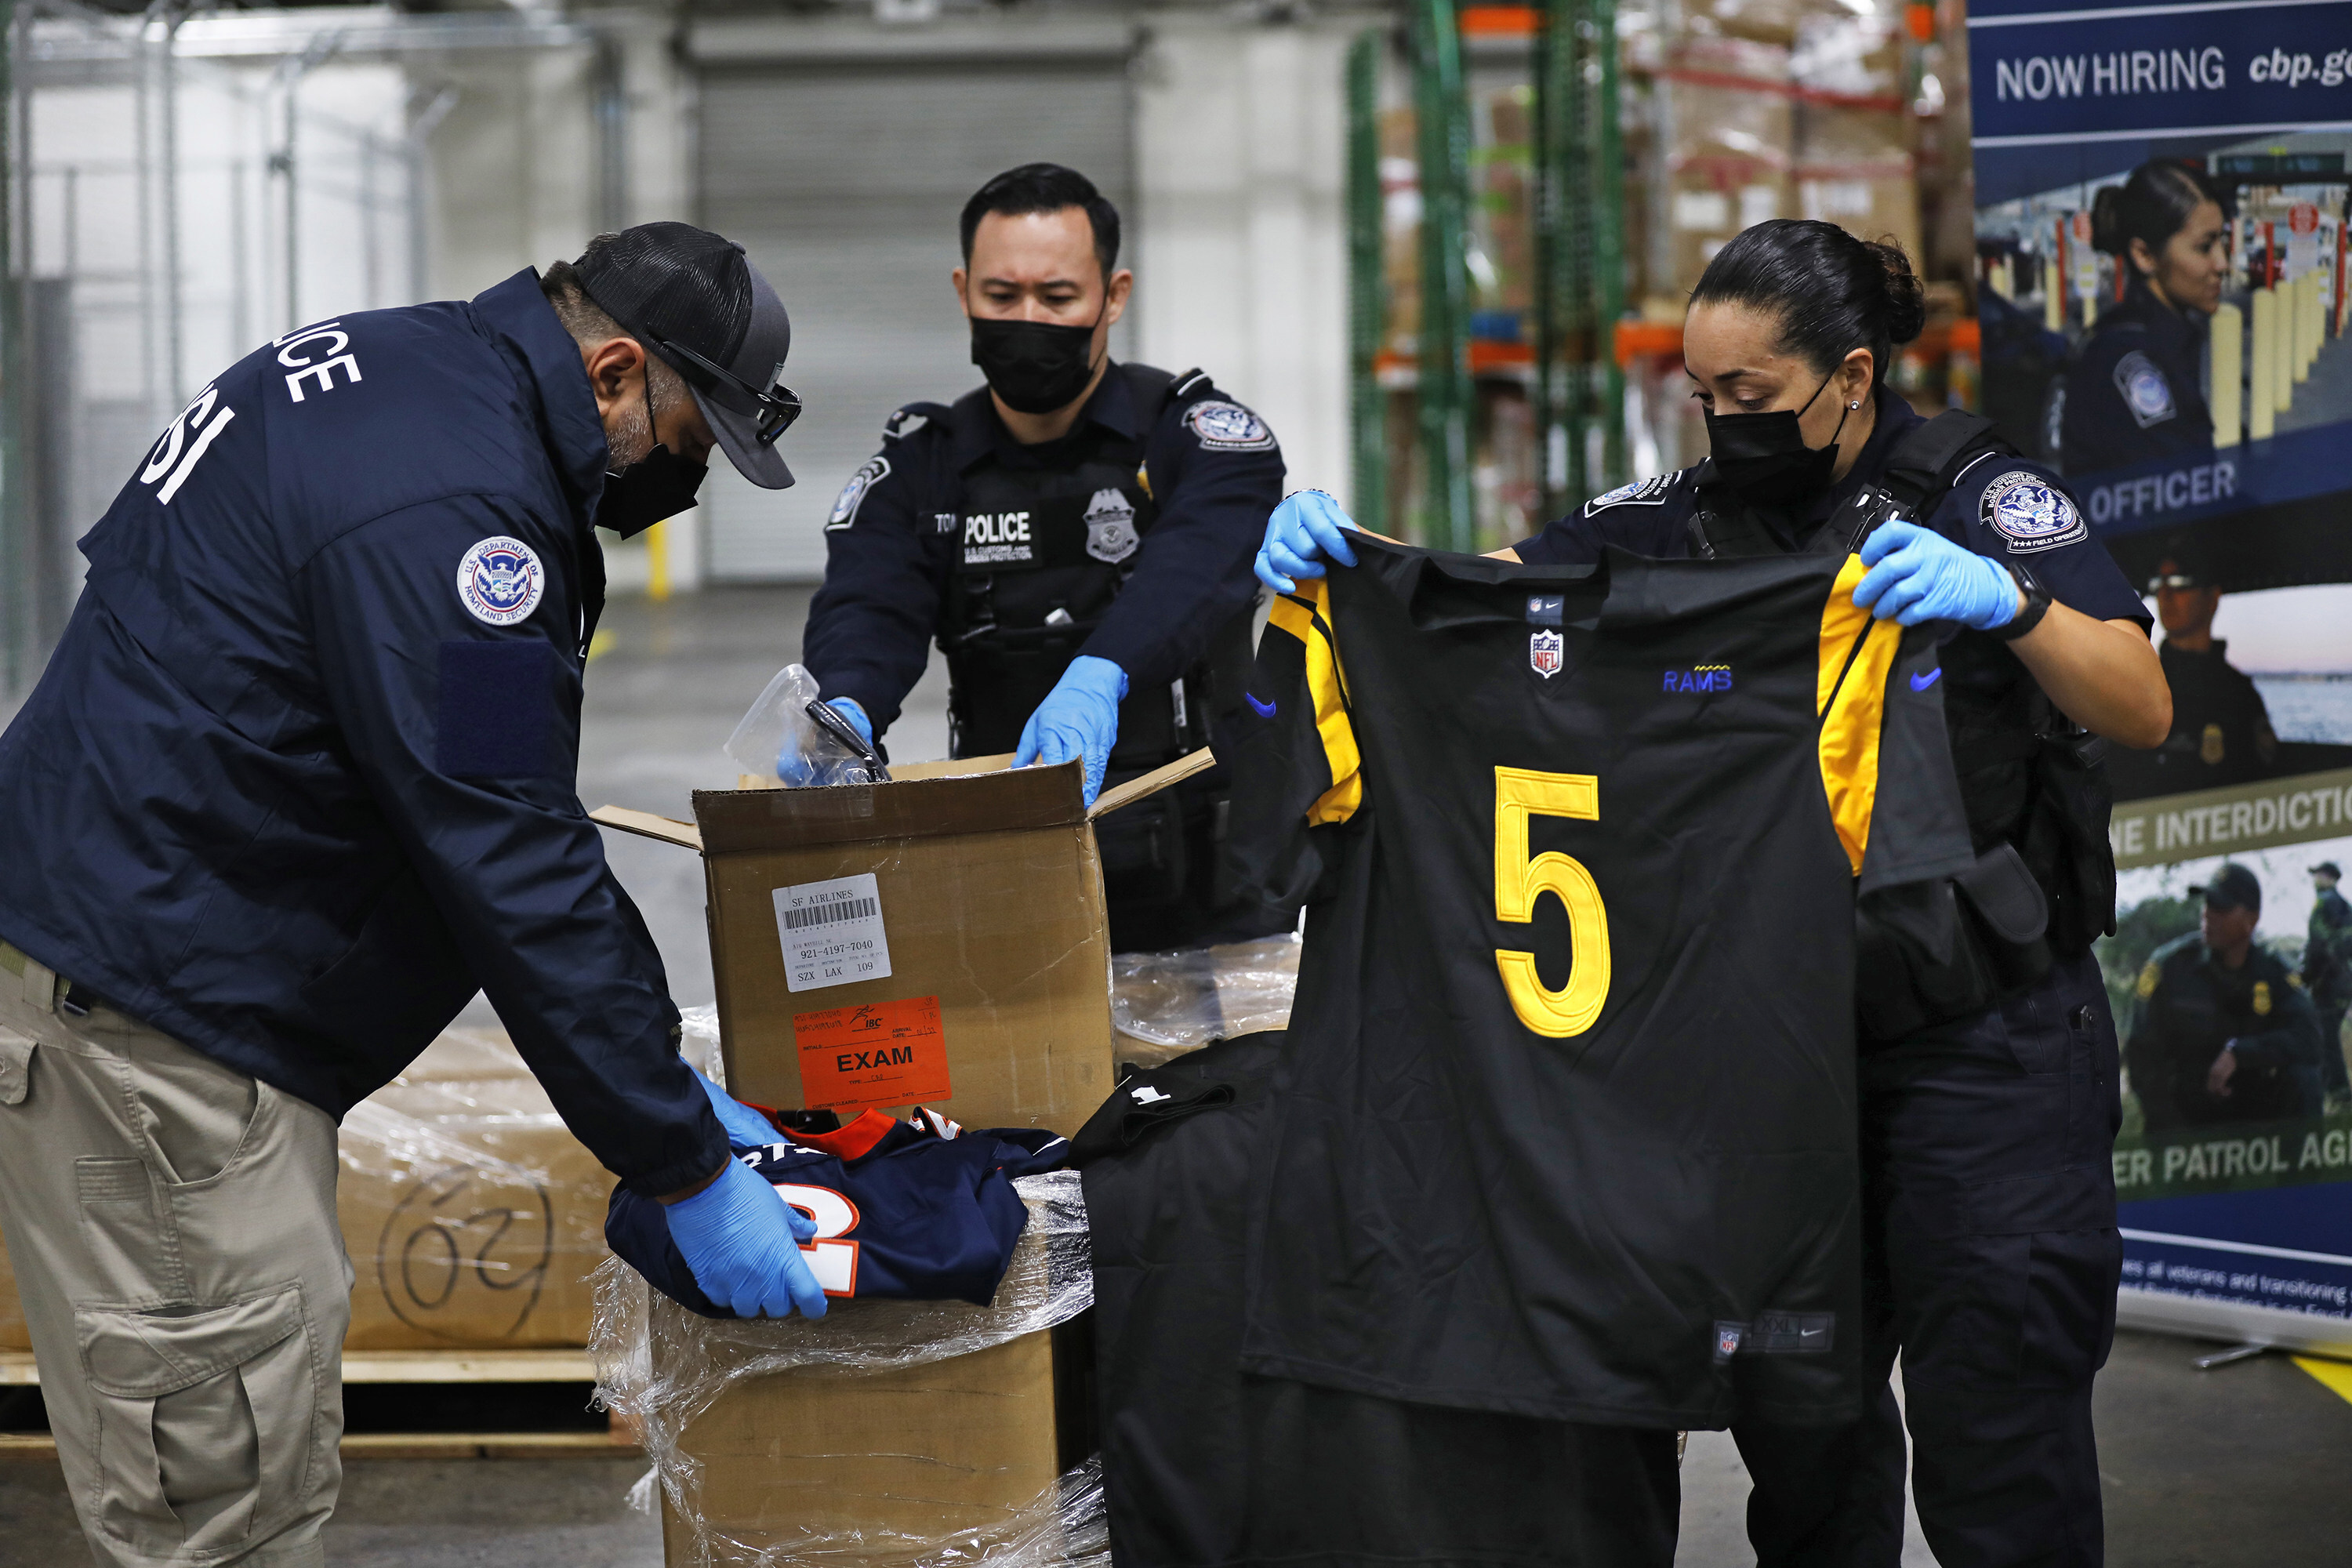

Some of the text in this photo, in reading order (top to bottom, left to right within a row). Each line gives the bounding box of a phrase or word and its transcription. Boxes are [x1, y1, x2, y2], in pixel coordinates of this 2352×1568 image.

[1996, 54, 2087, 102] NOW
[2092, 46, 2226, 96] HIRING
[272, 321, 362, 403] ICE
[140, 382, 235, 506] SI
[1987, 477, 2046, 508] BORDER PROTECTION
[1993, 474, 2025, 488] CUSTOMS
[2089, 460, 2235, 525] OFFICER
[964, 511, 1032, 545] POLICE
[2032, 538, 2053, 546] FIELD
[477, 542, 533, 563] DEPARTMENT
[530, 564, 539, 577] OF
[465, 585, 539, 621] HOMELAND SECURITY
[1535, 652, 1559, 670] NFL
[1663, 670, 1733, 693] RAMS
[792, 889, 854, 907] SF AIRLINES
[1494, 765, 1612, 1039] 5
[800, 940, 873, 960] 921-4197-7040
[797, 961, 873, 982] SZX LAX 109
[866, 1018, 882, 1028] IBC
[837, 1046, 913, 1073] EXAM
[2163, 1137, 2289, 1183] PATROL
[2298, 1129, 2352, 1171] AG
[2229, 1272, 2258, 1292] and
